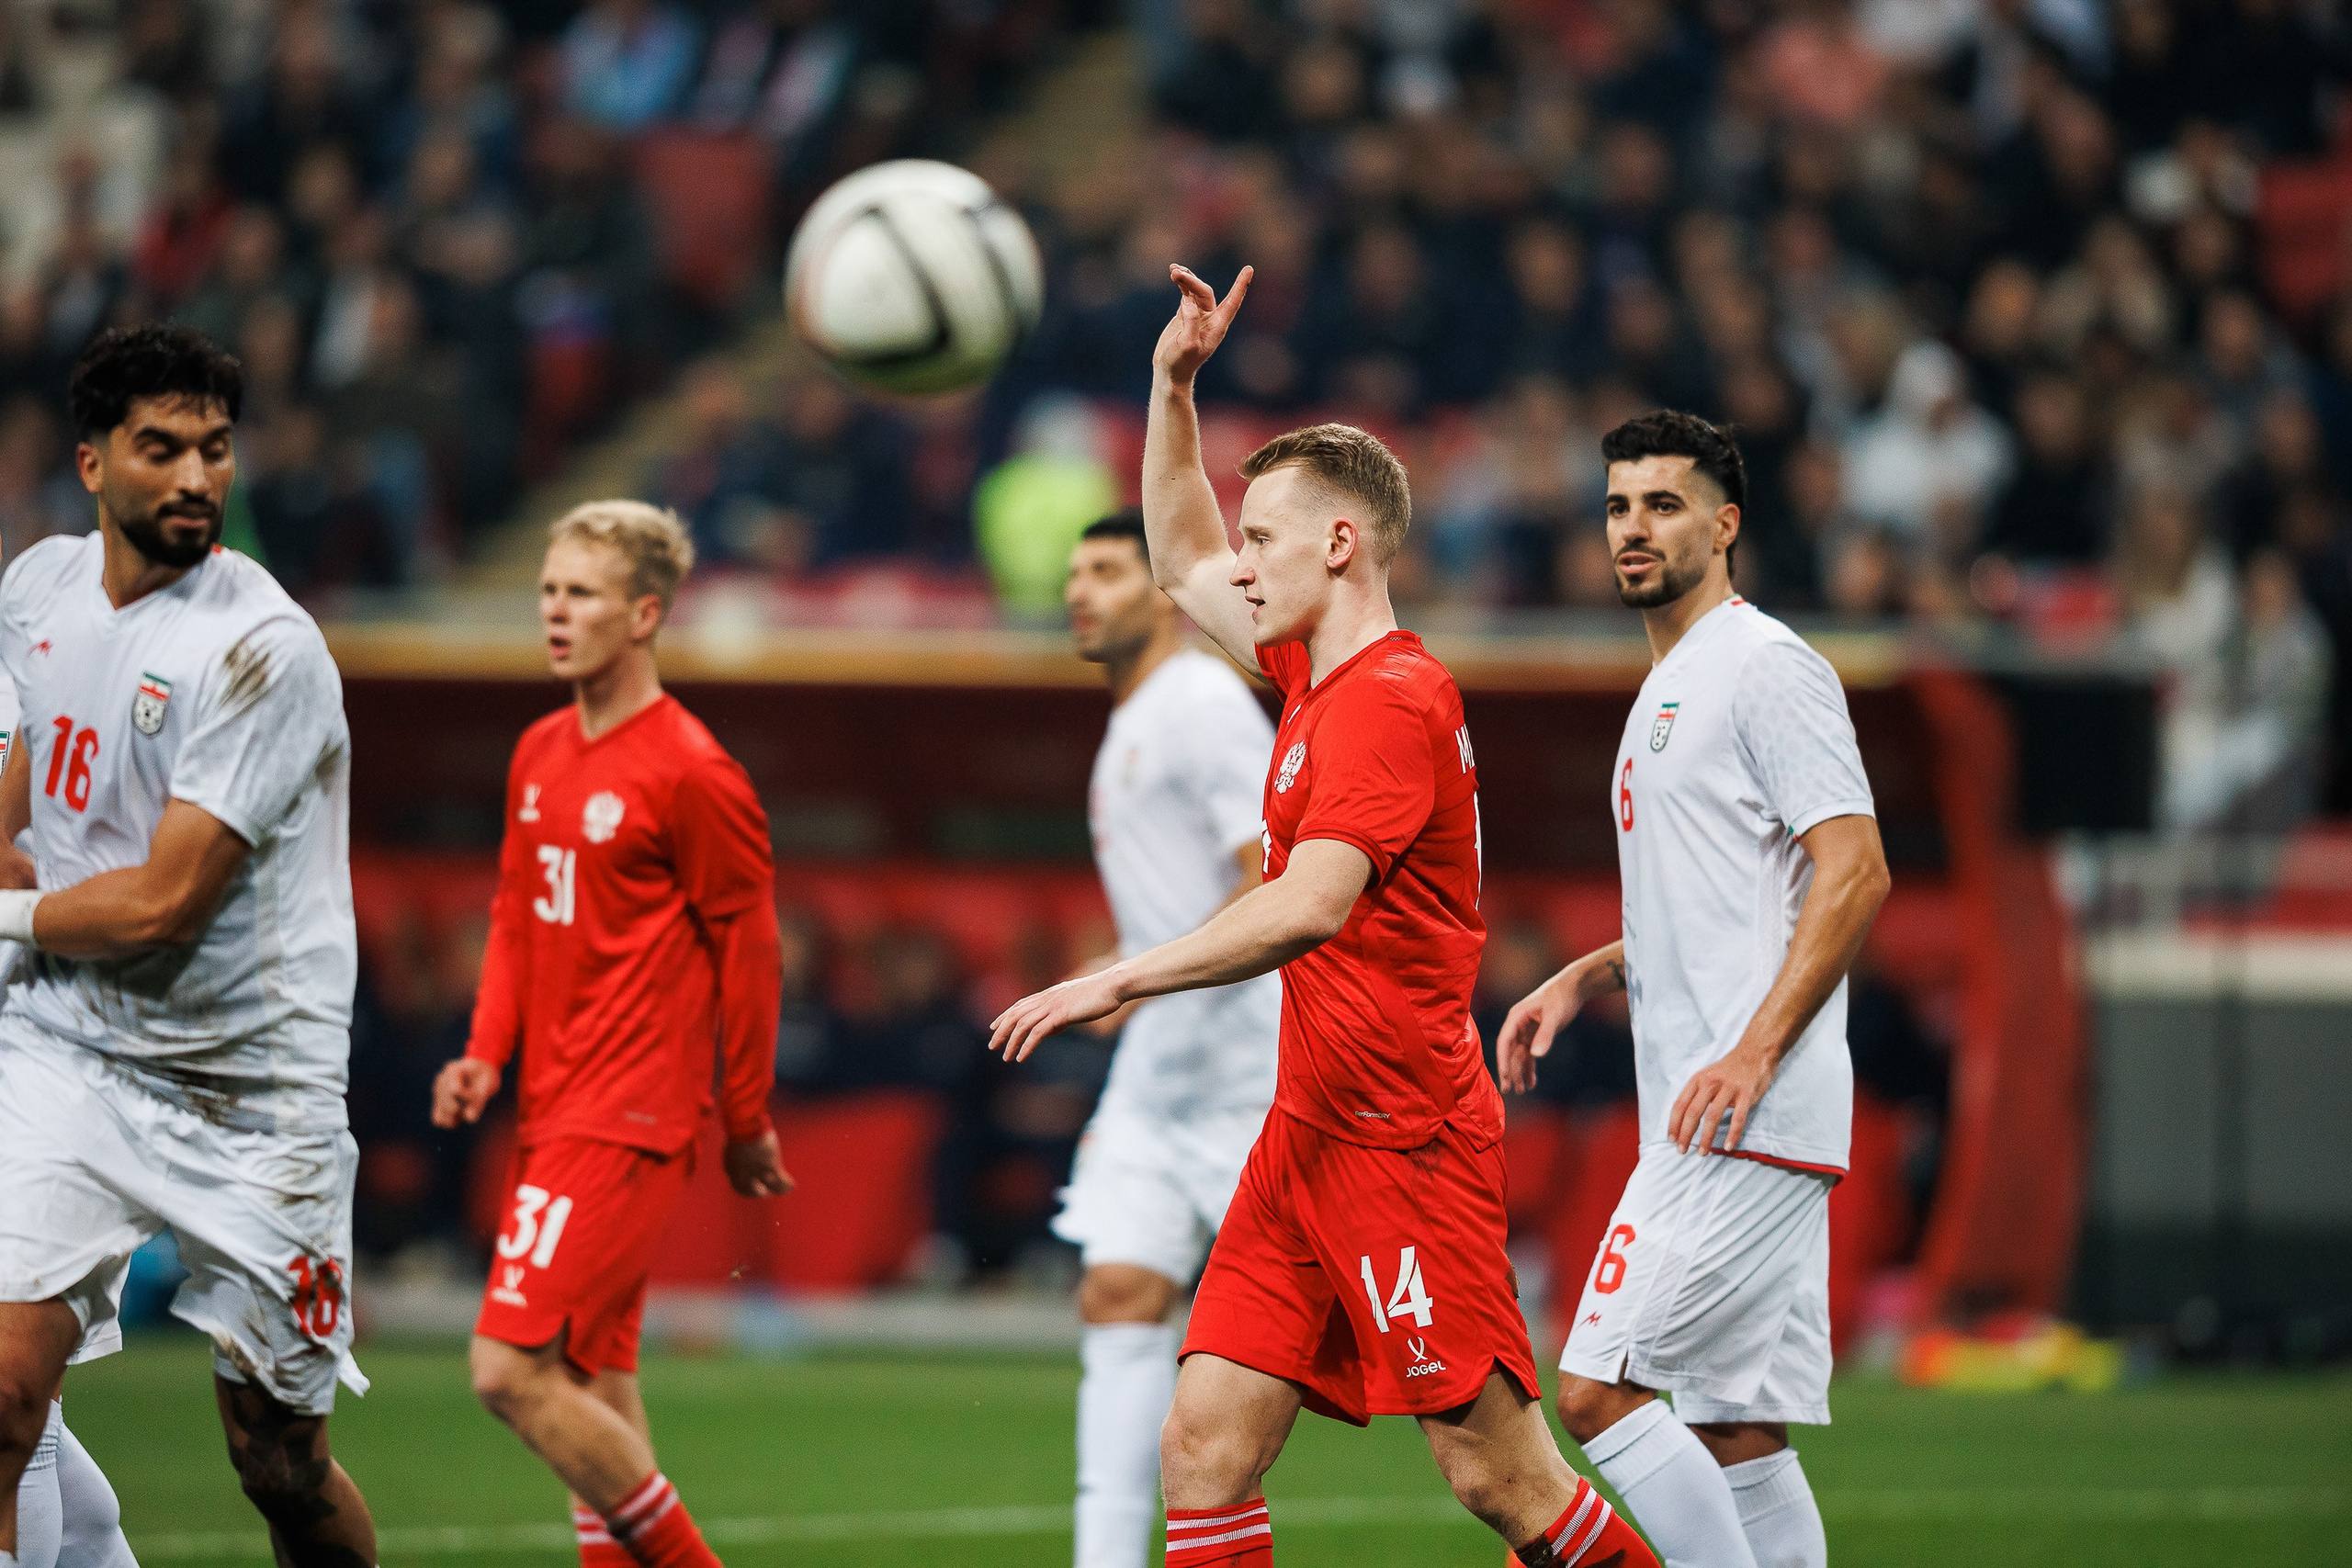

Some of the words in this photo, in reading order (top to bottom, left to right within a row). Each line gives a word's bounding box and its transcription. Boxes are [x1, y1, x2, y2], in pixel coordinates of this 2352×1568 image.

[44, 714, 99, 814] 16
[1621, 757, 1634, 832] 6
[533, 843, 576, 927] 31
[496, 1183, 574, 1269] 31
[1594, 1223, 1635, 1295] 6
[1361, 1245, 1433, 1334] 14
